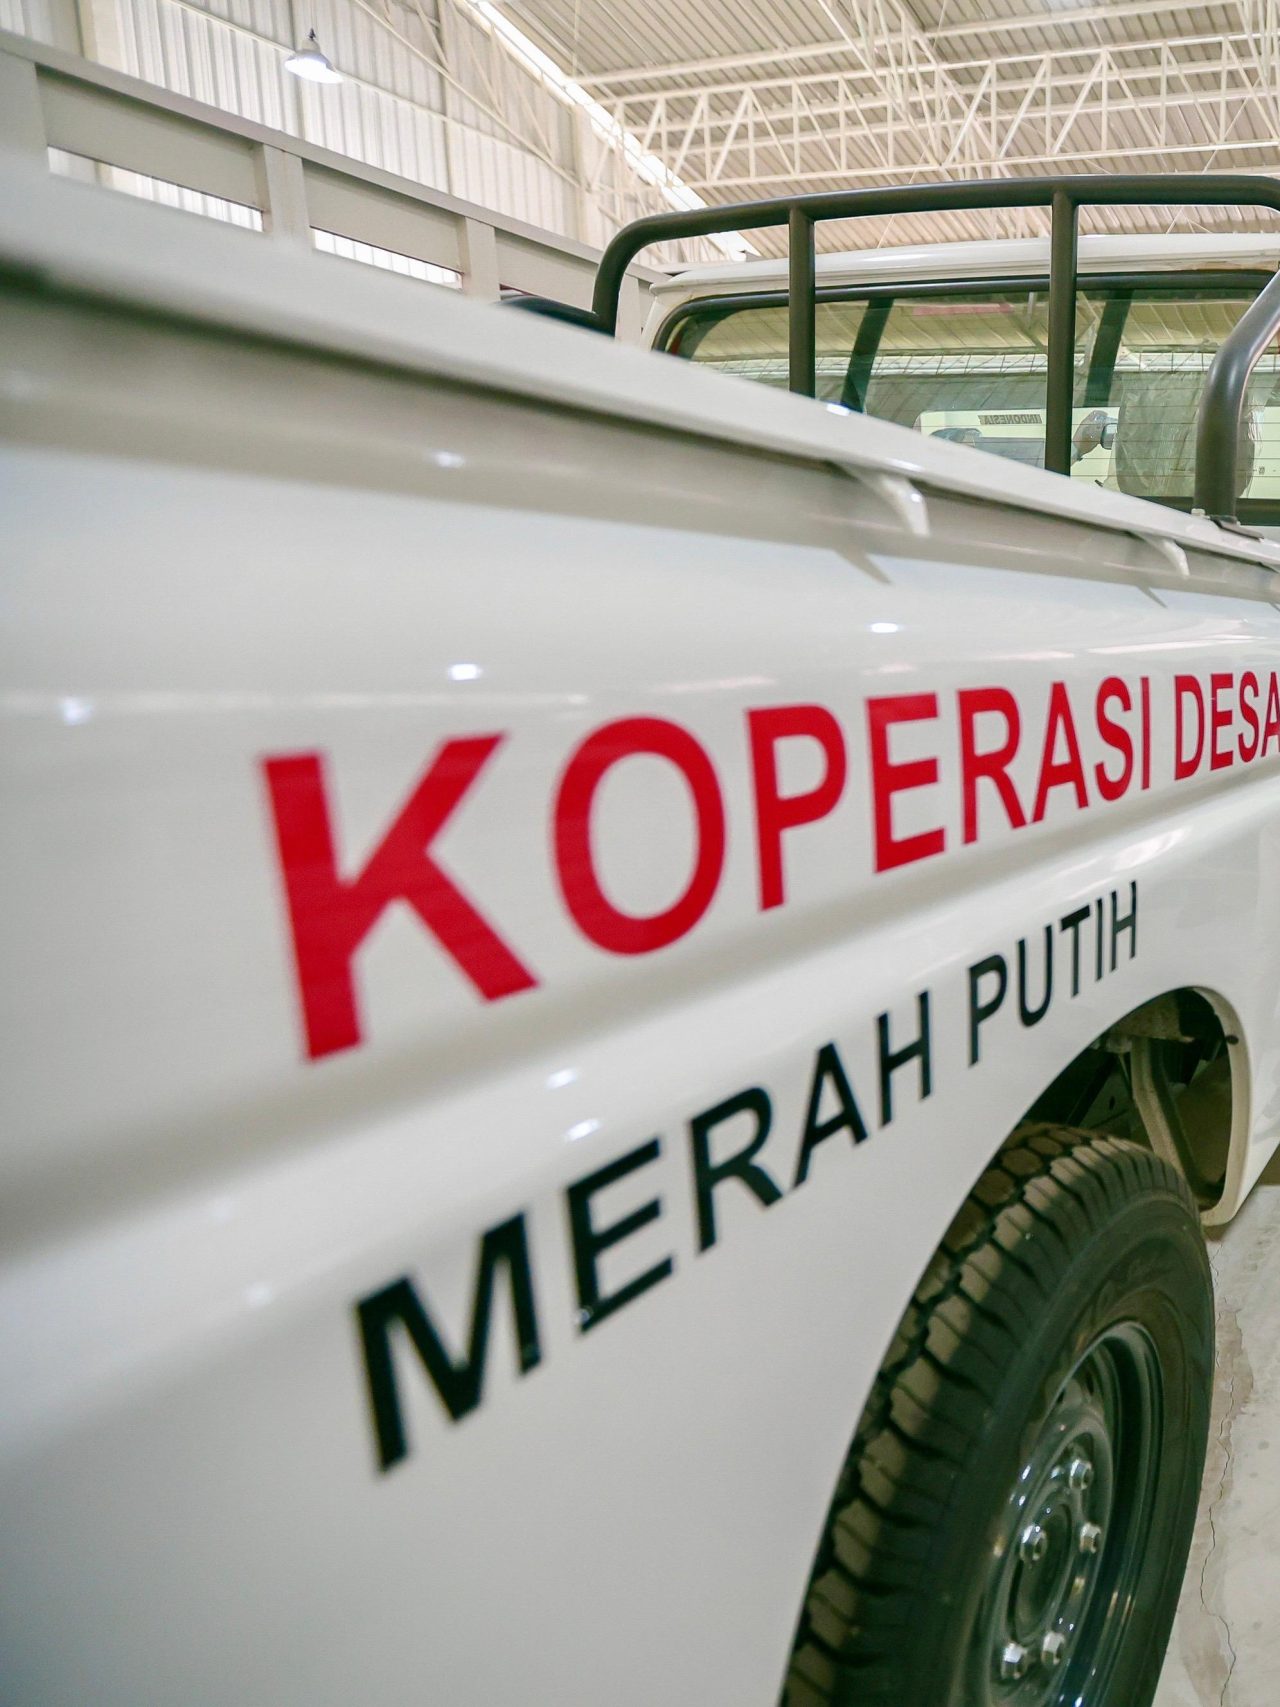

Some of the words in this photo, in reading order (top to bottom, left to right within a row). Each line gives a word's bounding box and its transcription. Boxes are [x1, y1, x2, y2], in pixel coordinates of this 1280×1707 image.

[259, 676, 1151, 1063] KOPERASI
[353, 988, 932, 1475] MERAH
[967, 881, 1138, 1067] PUTIH
